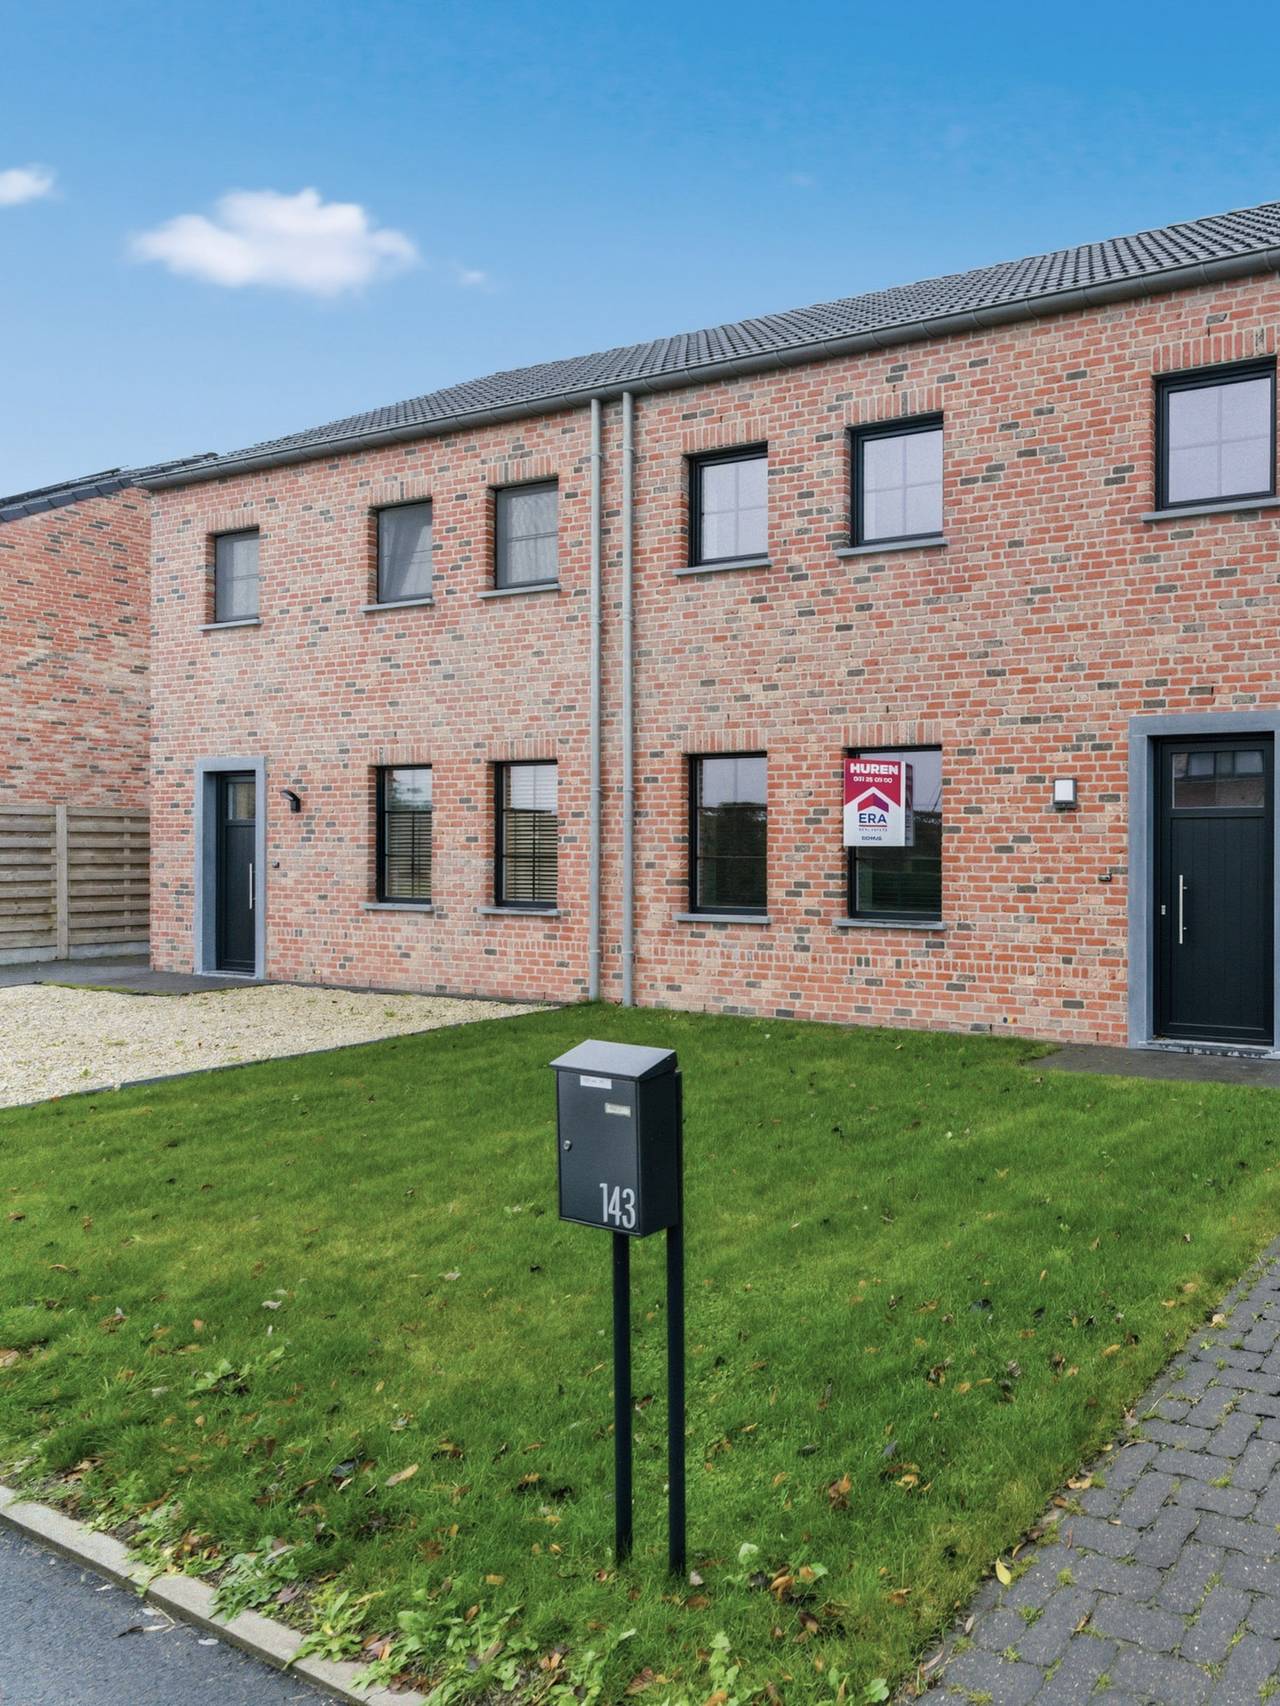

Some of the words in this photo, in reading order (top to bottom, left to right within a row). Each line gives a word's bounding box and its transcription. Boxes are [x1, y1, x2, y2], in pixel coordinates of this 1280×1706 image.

[850, 763, 898, 775] HUREN
[858, 813, 887, 824] ERA
[600, 1183, 636, 1229] 143
